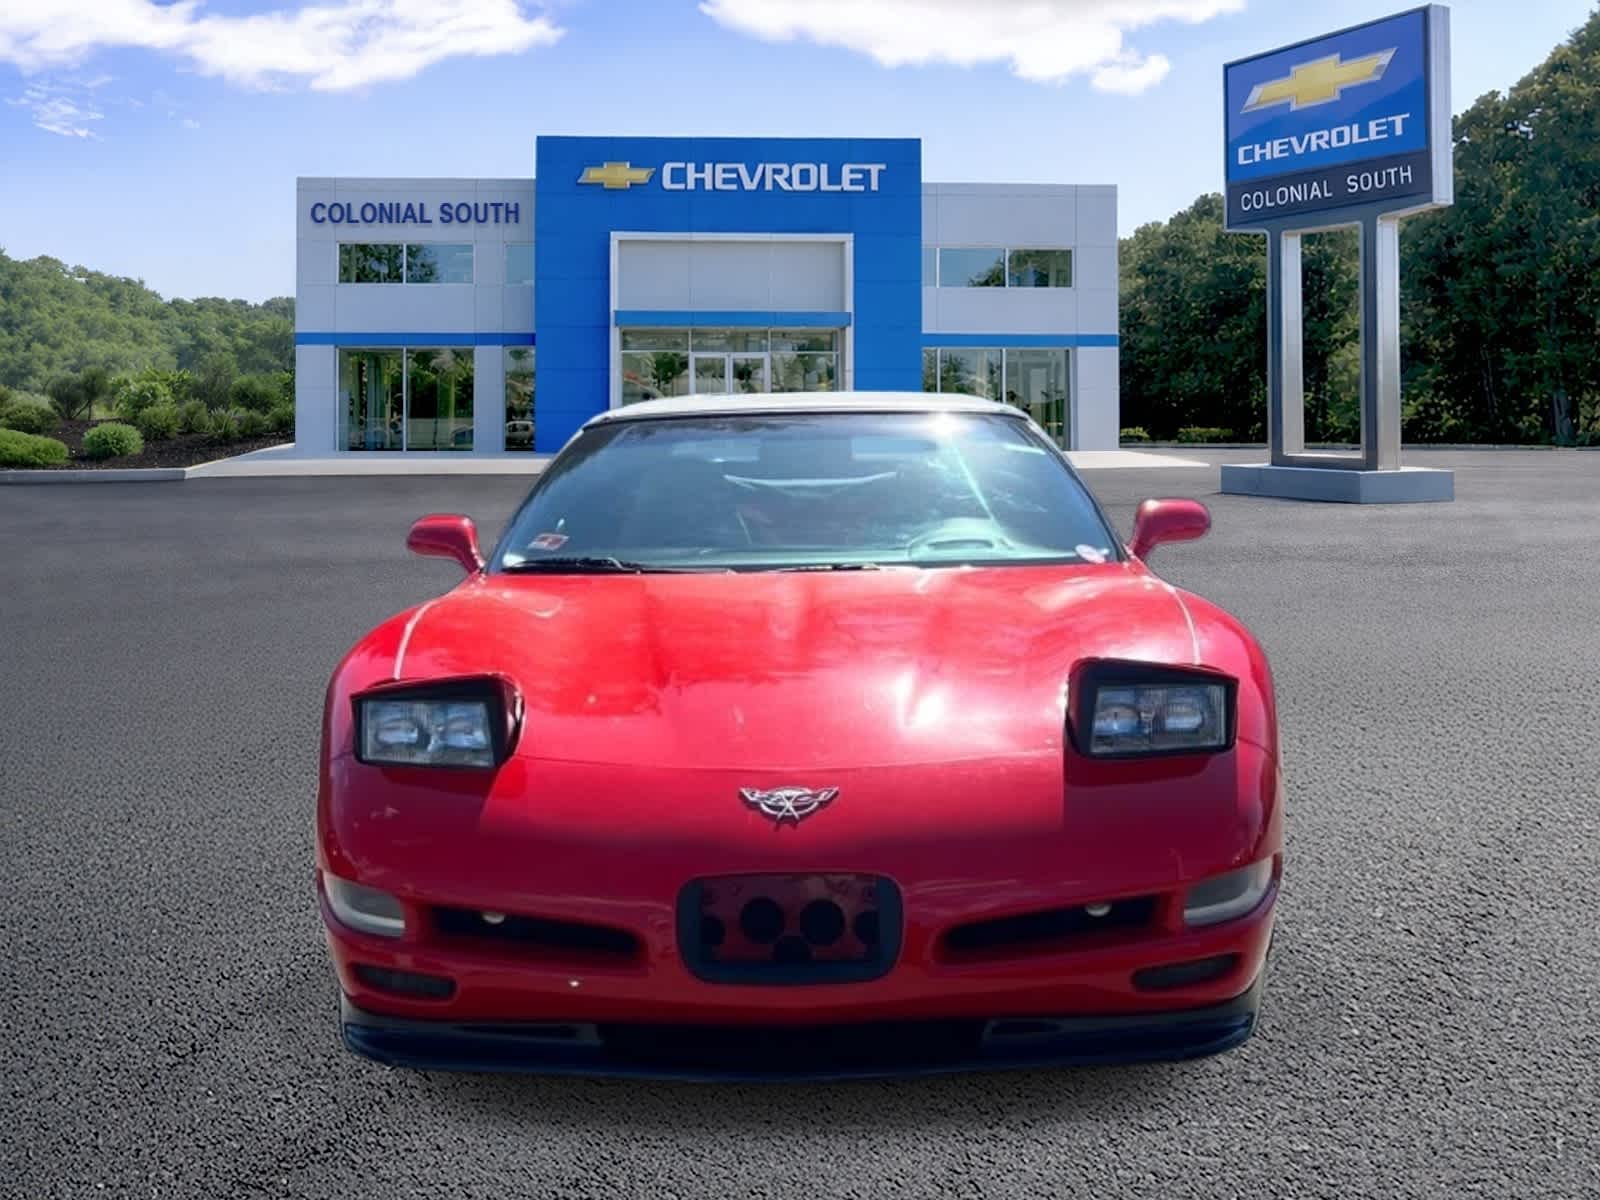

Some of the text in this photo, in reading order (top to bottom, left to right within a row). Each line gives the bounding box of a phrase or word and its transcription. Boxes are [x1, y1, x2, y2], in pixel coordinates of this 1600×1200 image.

[1238, 113, 1410, 165] CHEVROLET
[661, 162, 887, 192] CHEVROLET
[1240, 165, 1412, 211] COLONIAL SOUTH
[310, 202, 520, 224] COLONIAL SOUTH
